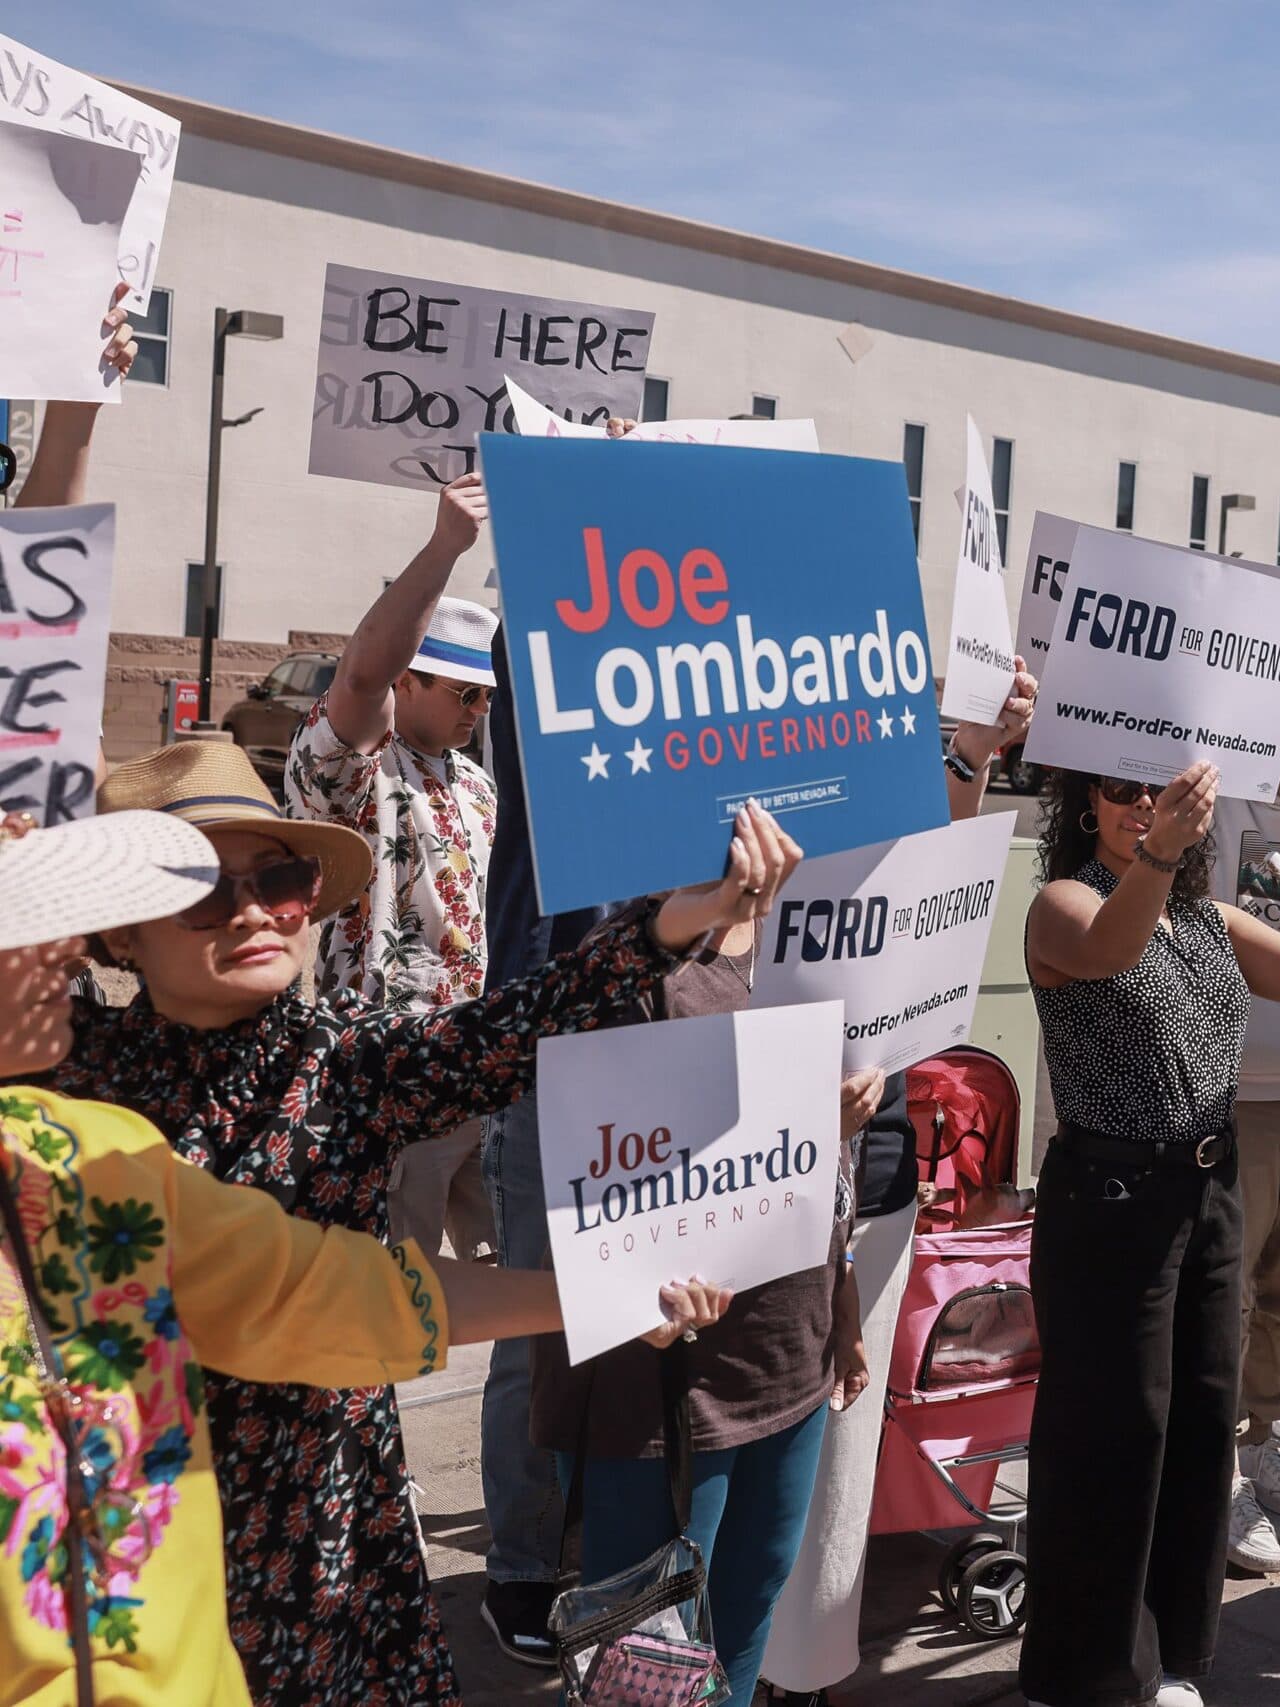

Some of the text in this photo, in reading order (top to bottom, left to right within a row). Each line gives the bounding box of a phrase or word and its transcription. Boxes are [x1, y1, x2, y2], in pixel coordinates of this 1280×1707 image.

[0, 49, 50, 117] YS
[60, 93, 177, 170] AWAY
[363, 287, 648, 375] BE HERE
[963, 489, 991, 572] FORD
[555, 528, 730, 633] Joe
[1032, 554, 1070, 602] FO
[1065, 587, 1177, 662] FORD
[1179, 626, 1204, 652] FOR
[178, 693, 199, 704] AIR
[527, 609, 927, 735] Lombardo
[664, 709, 873, 771] GOVERNOR
[773, 791, 800, 806] BETTER
[800, 787, 827, 801] NEVADA
[827, 783, 841, 796] PAC
[773, 879, 995, 964] FORD FOR GOVERNOR
[569, 1128, 818, 1235] Lombardo
[589, 1123, 672, 1179] Joe
[599, 1191, 797, 1262] GOVERNOR
